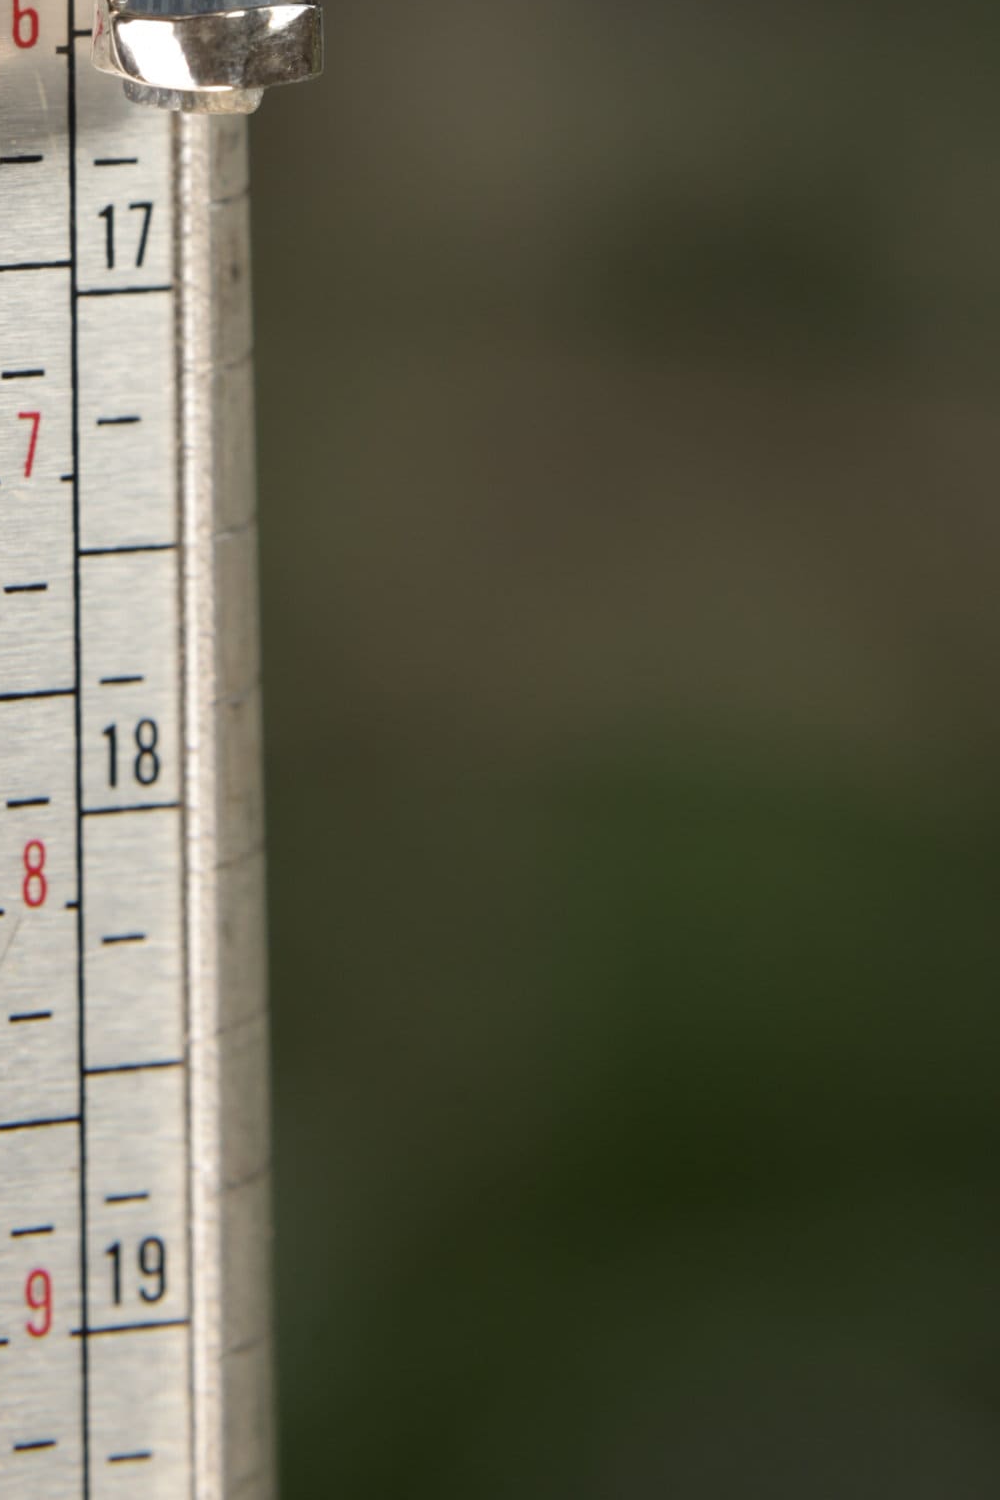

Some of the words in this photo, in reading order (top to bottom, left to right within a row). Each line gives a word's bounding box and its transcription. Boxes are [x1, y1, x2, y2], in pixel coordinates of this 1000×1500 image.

[99, 202, 154, 269] 17
[18, 410, 42, 479] 7
[102, 719, 160, 788] 18
[22, 838, 49, 909] 8
[24, 1268, 54, 1338] 9
[105, 1236, 167, 1305] 19
